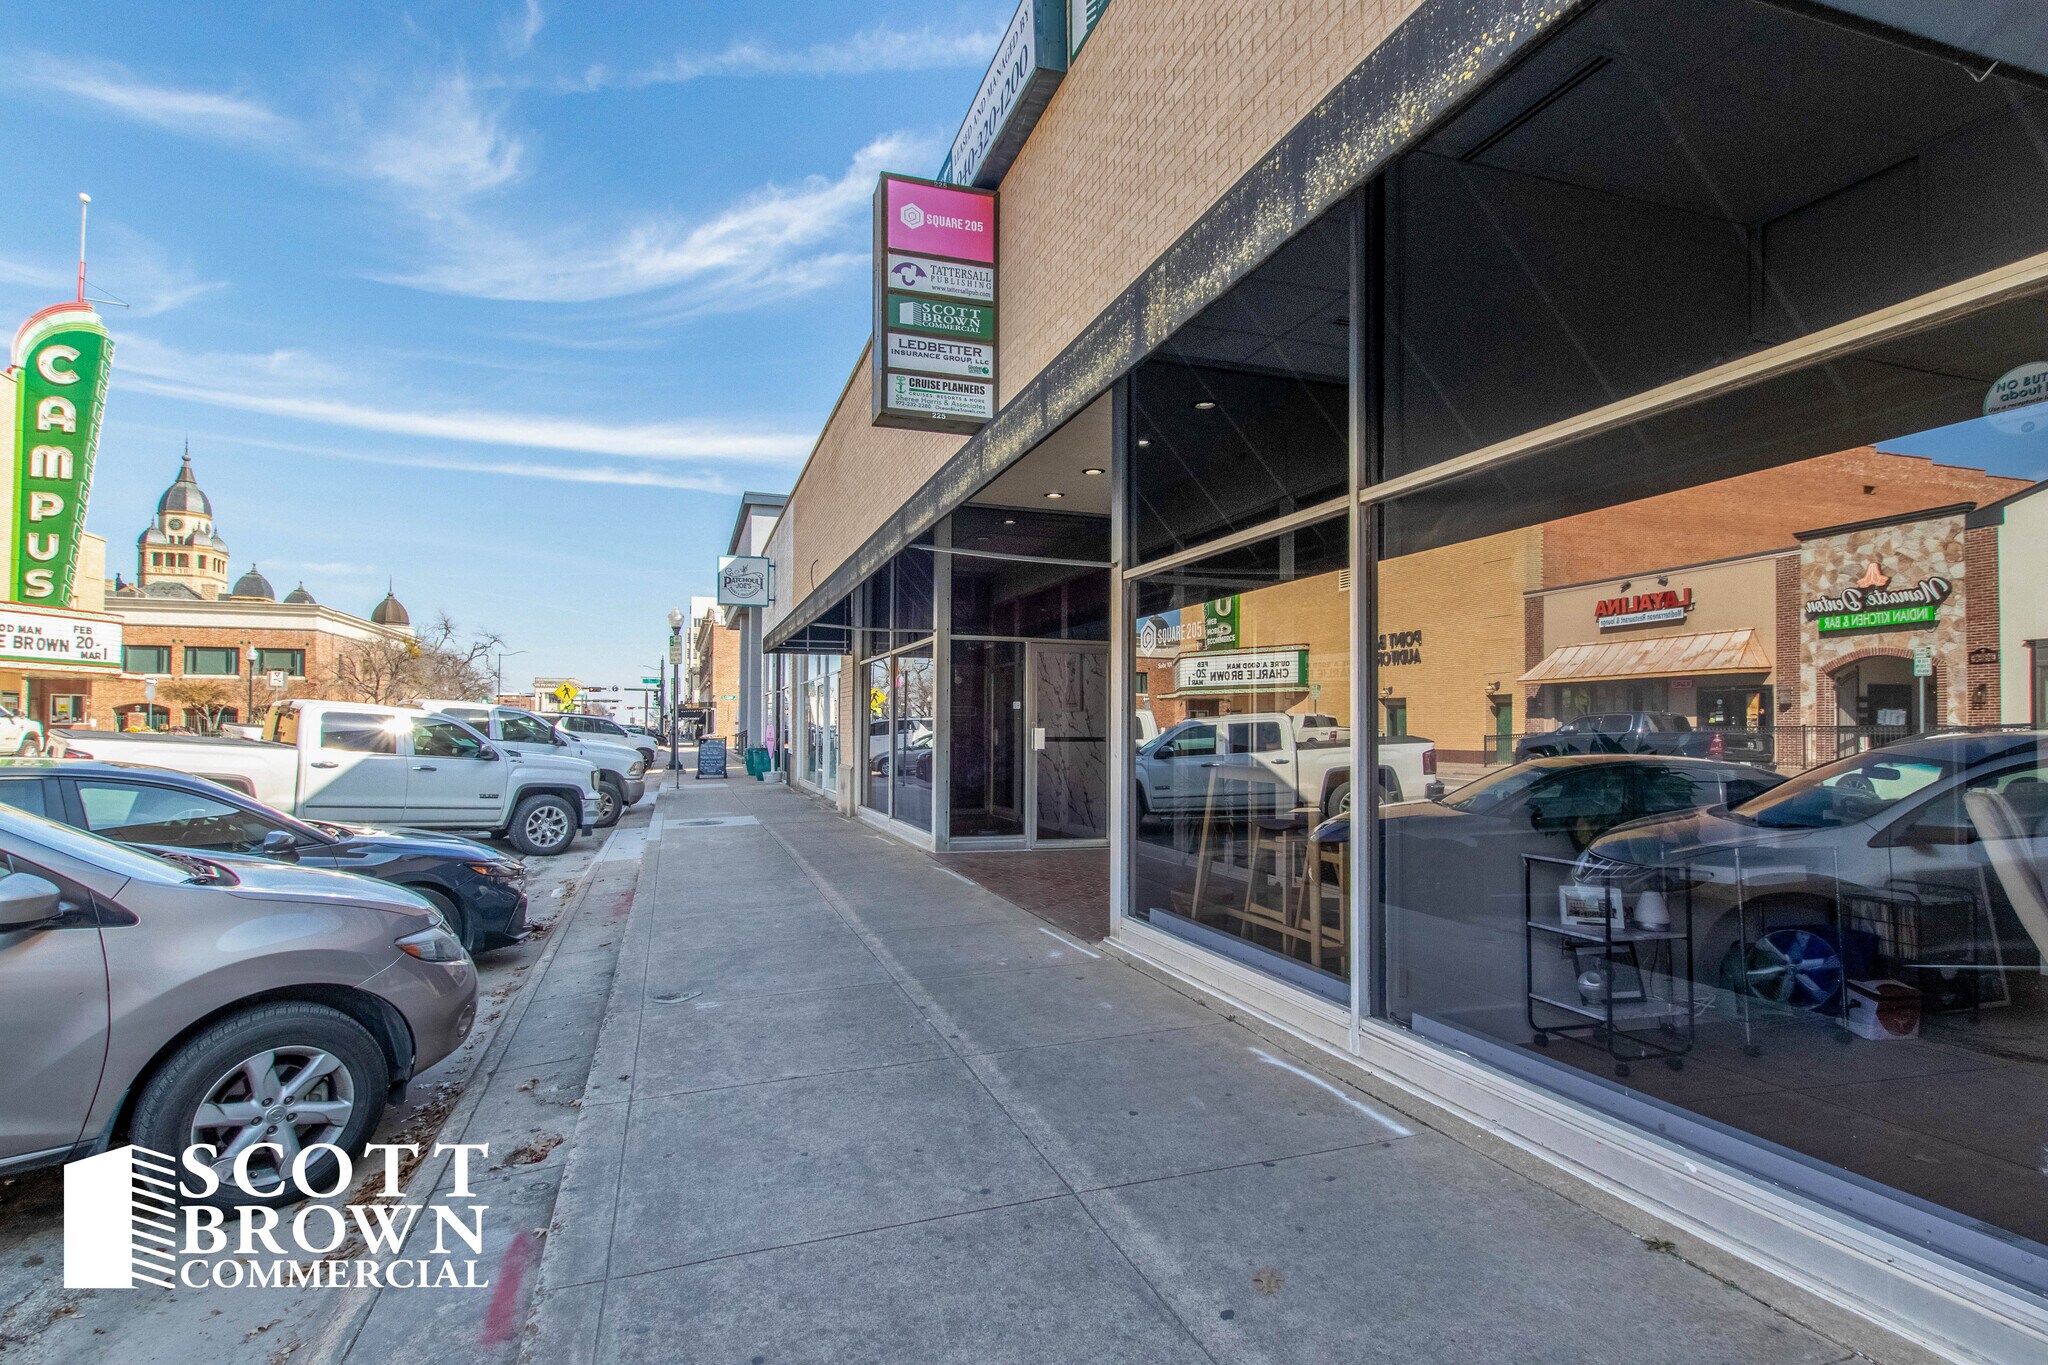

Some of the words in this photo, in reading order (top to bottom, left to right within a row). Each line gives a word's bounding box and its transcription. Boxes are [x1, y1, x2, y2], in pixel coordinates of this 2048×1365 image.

[973, 97, 986, 125] AND
[987, 31, 1019, 97] MANAGED
[1019, 11, 1030, 34] BY
[926, 214, 963, 230] SQUARE
[964, 220, 984, 232] 205
[930, 265, 992, 282] TATTERSALL
[930, 275, 992, 290] PUBLISHING
[931, 285, 991, 298] www.tattersallpub.com
[921, 303, 981, 319] SCOTT
[922, 312, 980, 328] BROWN
[922, 321, 981, 333] COMMERCIAL
[898, 338, 982, 357] LEDBETTER
[891, 348, 940, 360] INSURANCE
[943, 354, 973, 364] GROUP,
[909, 377, 940, 391] CRUISE
[942, 381, 985, 395] PLANNERS
[1996, 380, 2019, 393] NO
[2000, 384, 2042, 401] about
[895, 394, 919, 403] Sheree
[921, 397, 942, 405] Harris
[951, 401, 986, 410] Associates
[23, 344, 82, 600] CAMPUS
[723, 575, 764, 590] PATCHOULI
[18, 625, 42, 635] MAN
[73, 625, 93, 635] FEB
[1157, 624, 1185, 644] SQUARE
[1186, 621, 1202, 641] 205
[1207, 626, 1224, 636] MOBILE
[13, 636, 70, 652] BROWN
[1207, 635, 1236, 645] ECOMMERCE
[80, 651, 101, 660] MAR
